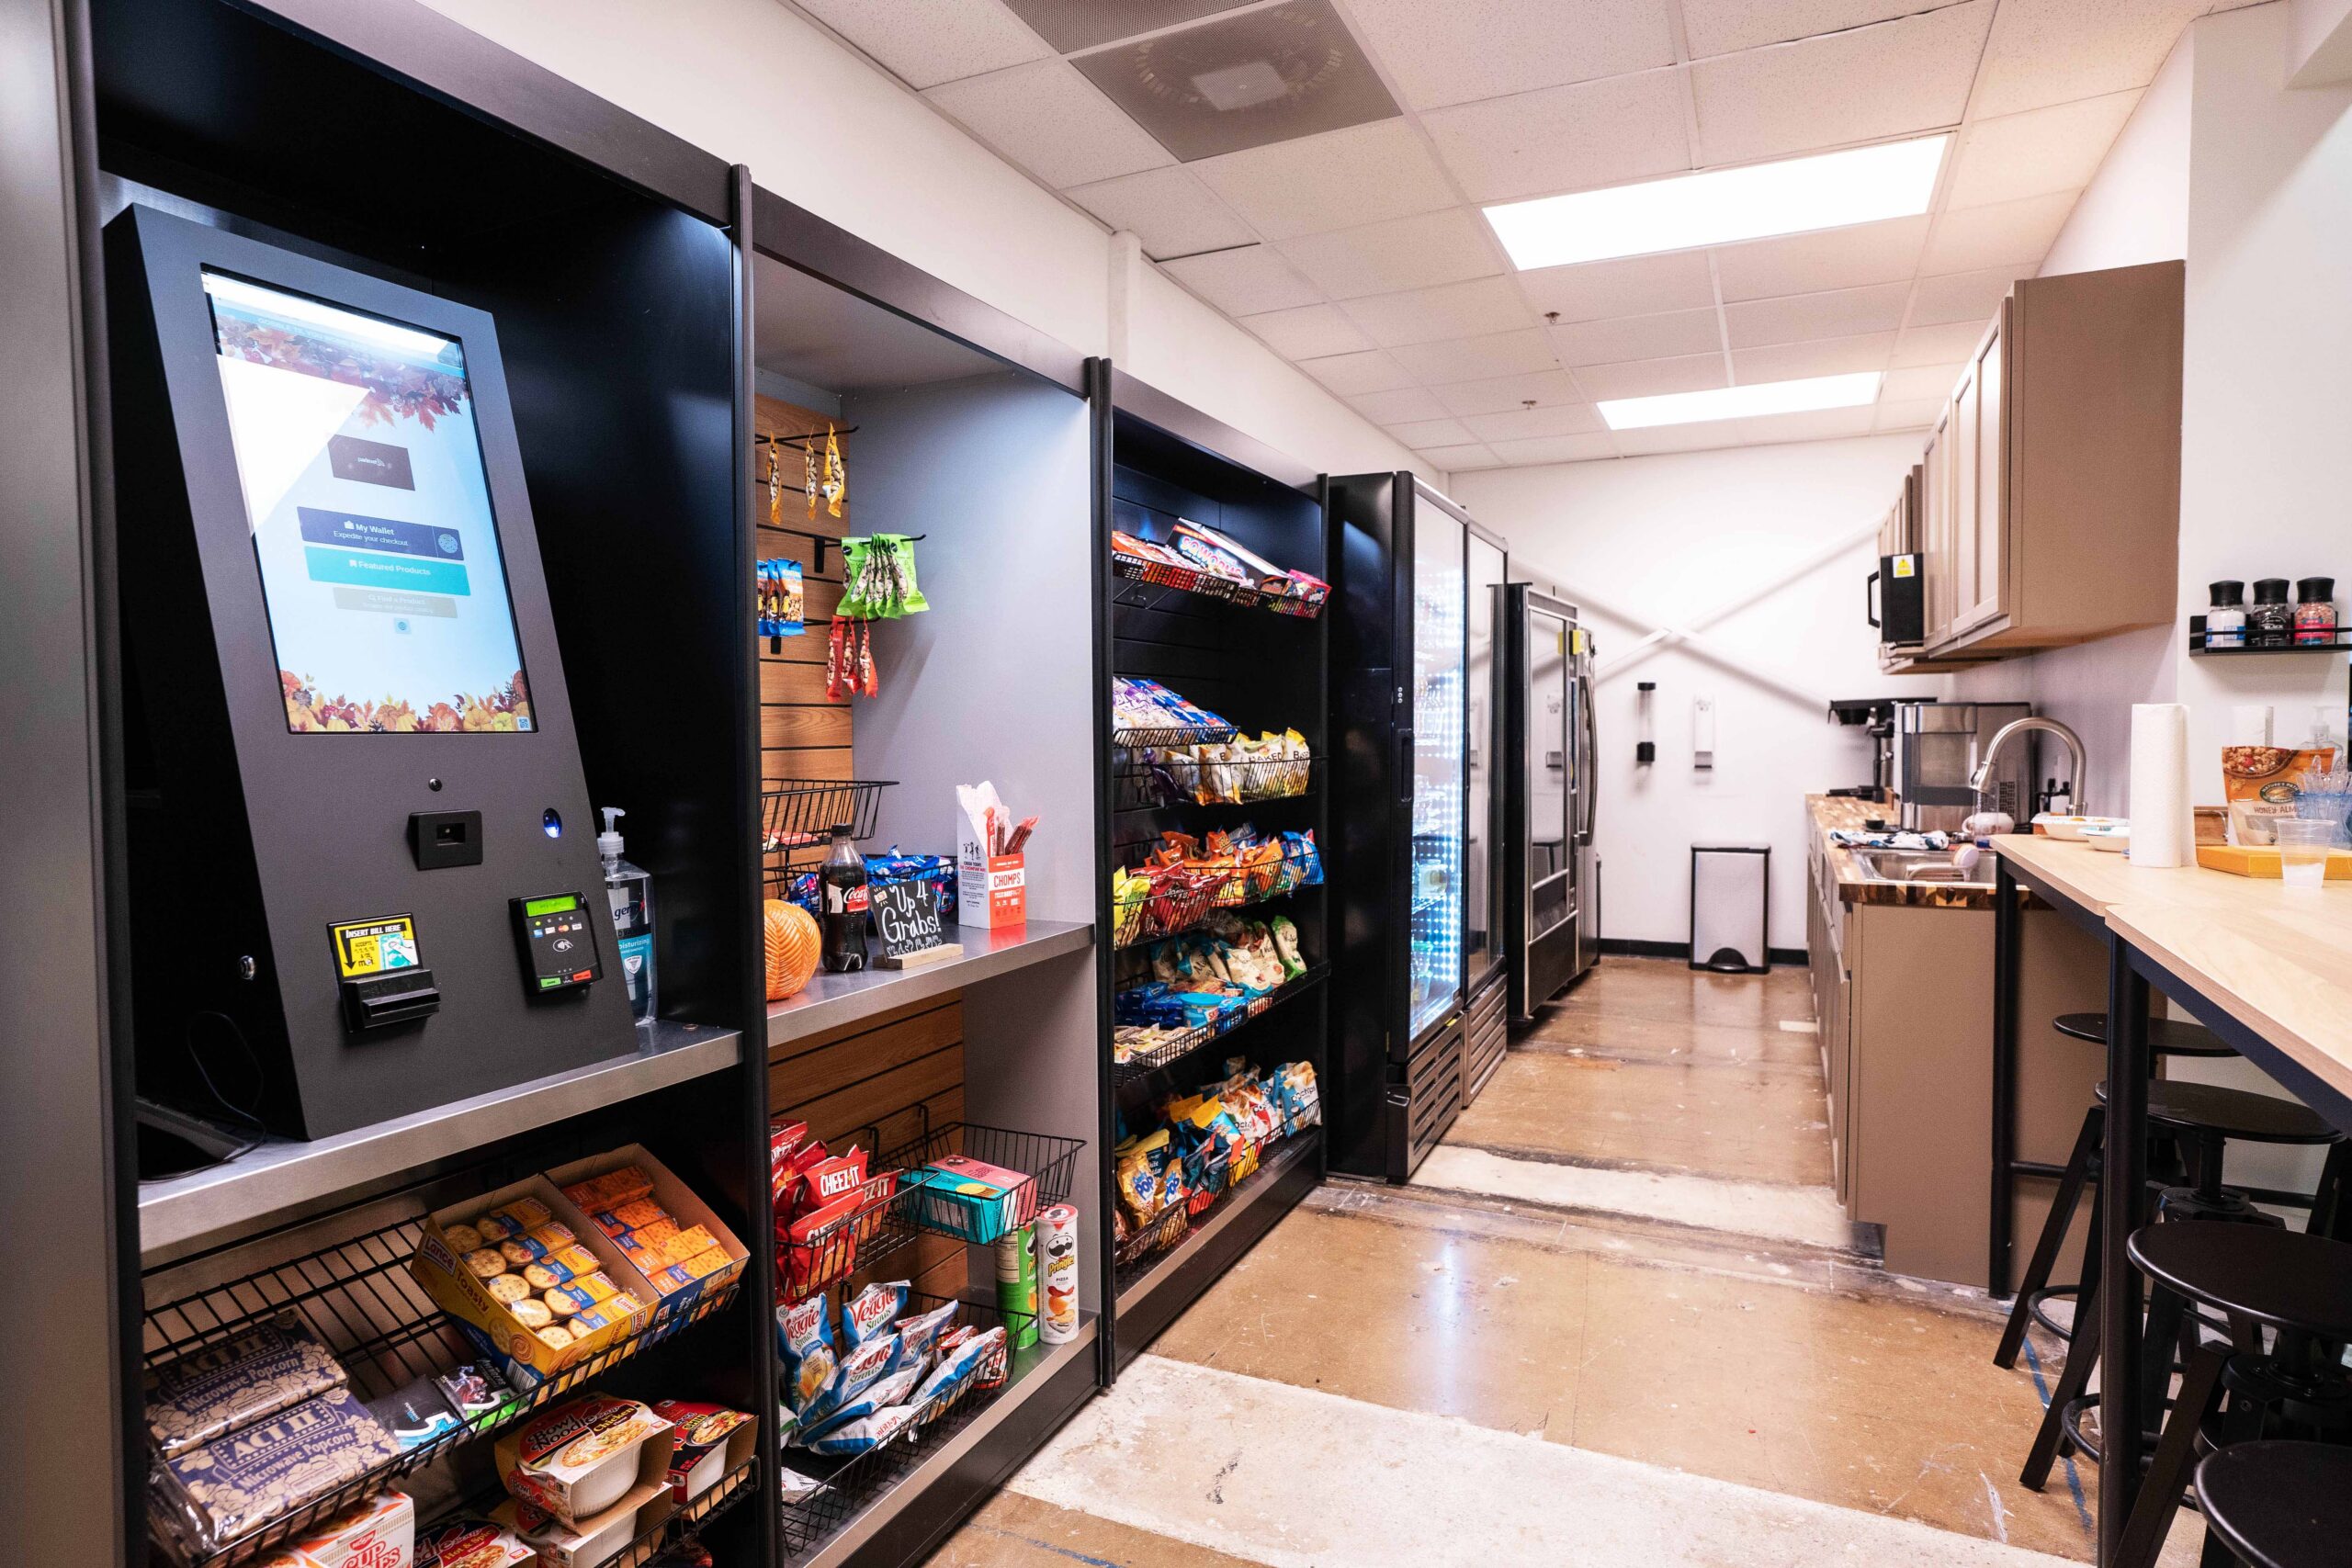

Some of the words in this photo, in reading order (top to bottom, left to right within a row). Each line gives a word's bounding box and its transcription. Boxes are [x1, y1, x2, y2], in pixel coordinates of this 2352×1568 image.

[334, 531, 363, 540] Expedite
[356, 524, 368, 534] My
[369, 525, 394, 536] Wallet
[358, 560, 394, 572] Featured
[396, 565, 431, 576] Products
[1249, 752, 1283, 762] BAKED
[993, 872, 1021, 888] CHOMPS
[889, 886, 916, 918] Up
[916, 880, 929, 907] 4
[345, 929, 369, 939] INSERT
[369, 926, 384, 934] BILL
[385, 924, 401, 932] HERE
[882, 900, 942, 943] Grabs!
[1136, 1176, 1154, 1201] POP
[1165, 1178, 1181, 1205] POP
[549, 1222, 572, 1239] Lance
[424, 1235, 455, 1269] Lance
[574, 1245, 598, 1262] Lance
[457, 1271, 490, 1314] Toasty
[850, 1286, 897, 1328] Veggie
[865, 1308, 892, 1332] Straws
[781, 1310, 820, 1342] Veggie
[182, 1375, 249, 1410] Microwave
[247, 1358, 300, 1381] Popcorn
[526, 1414, 577, 1443] Bowl
[530, 1416, 597, 1451] Noodle
[594, 1407, 634, 1433] Chicken
[683, 1415, 708, 1429] SHIN
[233, 1423, 287, 1460] ACT
[238, 1451, 305, 1491] Microwave
[302, 1433, 354, 1456] Popcorn
[444, 1548, 464, 1560] Hot
[470, 1529, 495, 1544] Spicy
